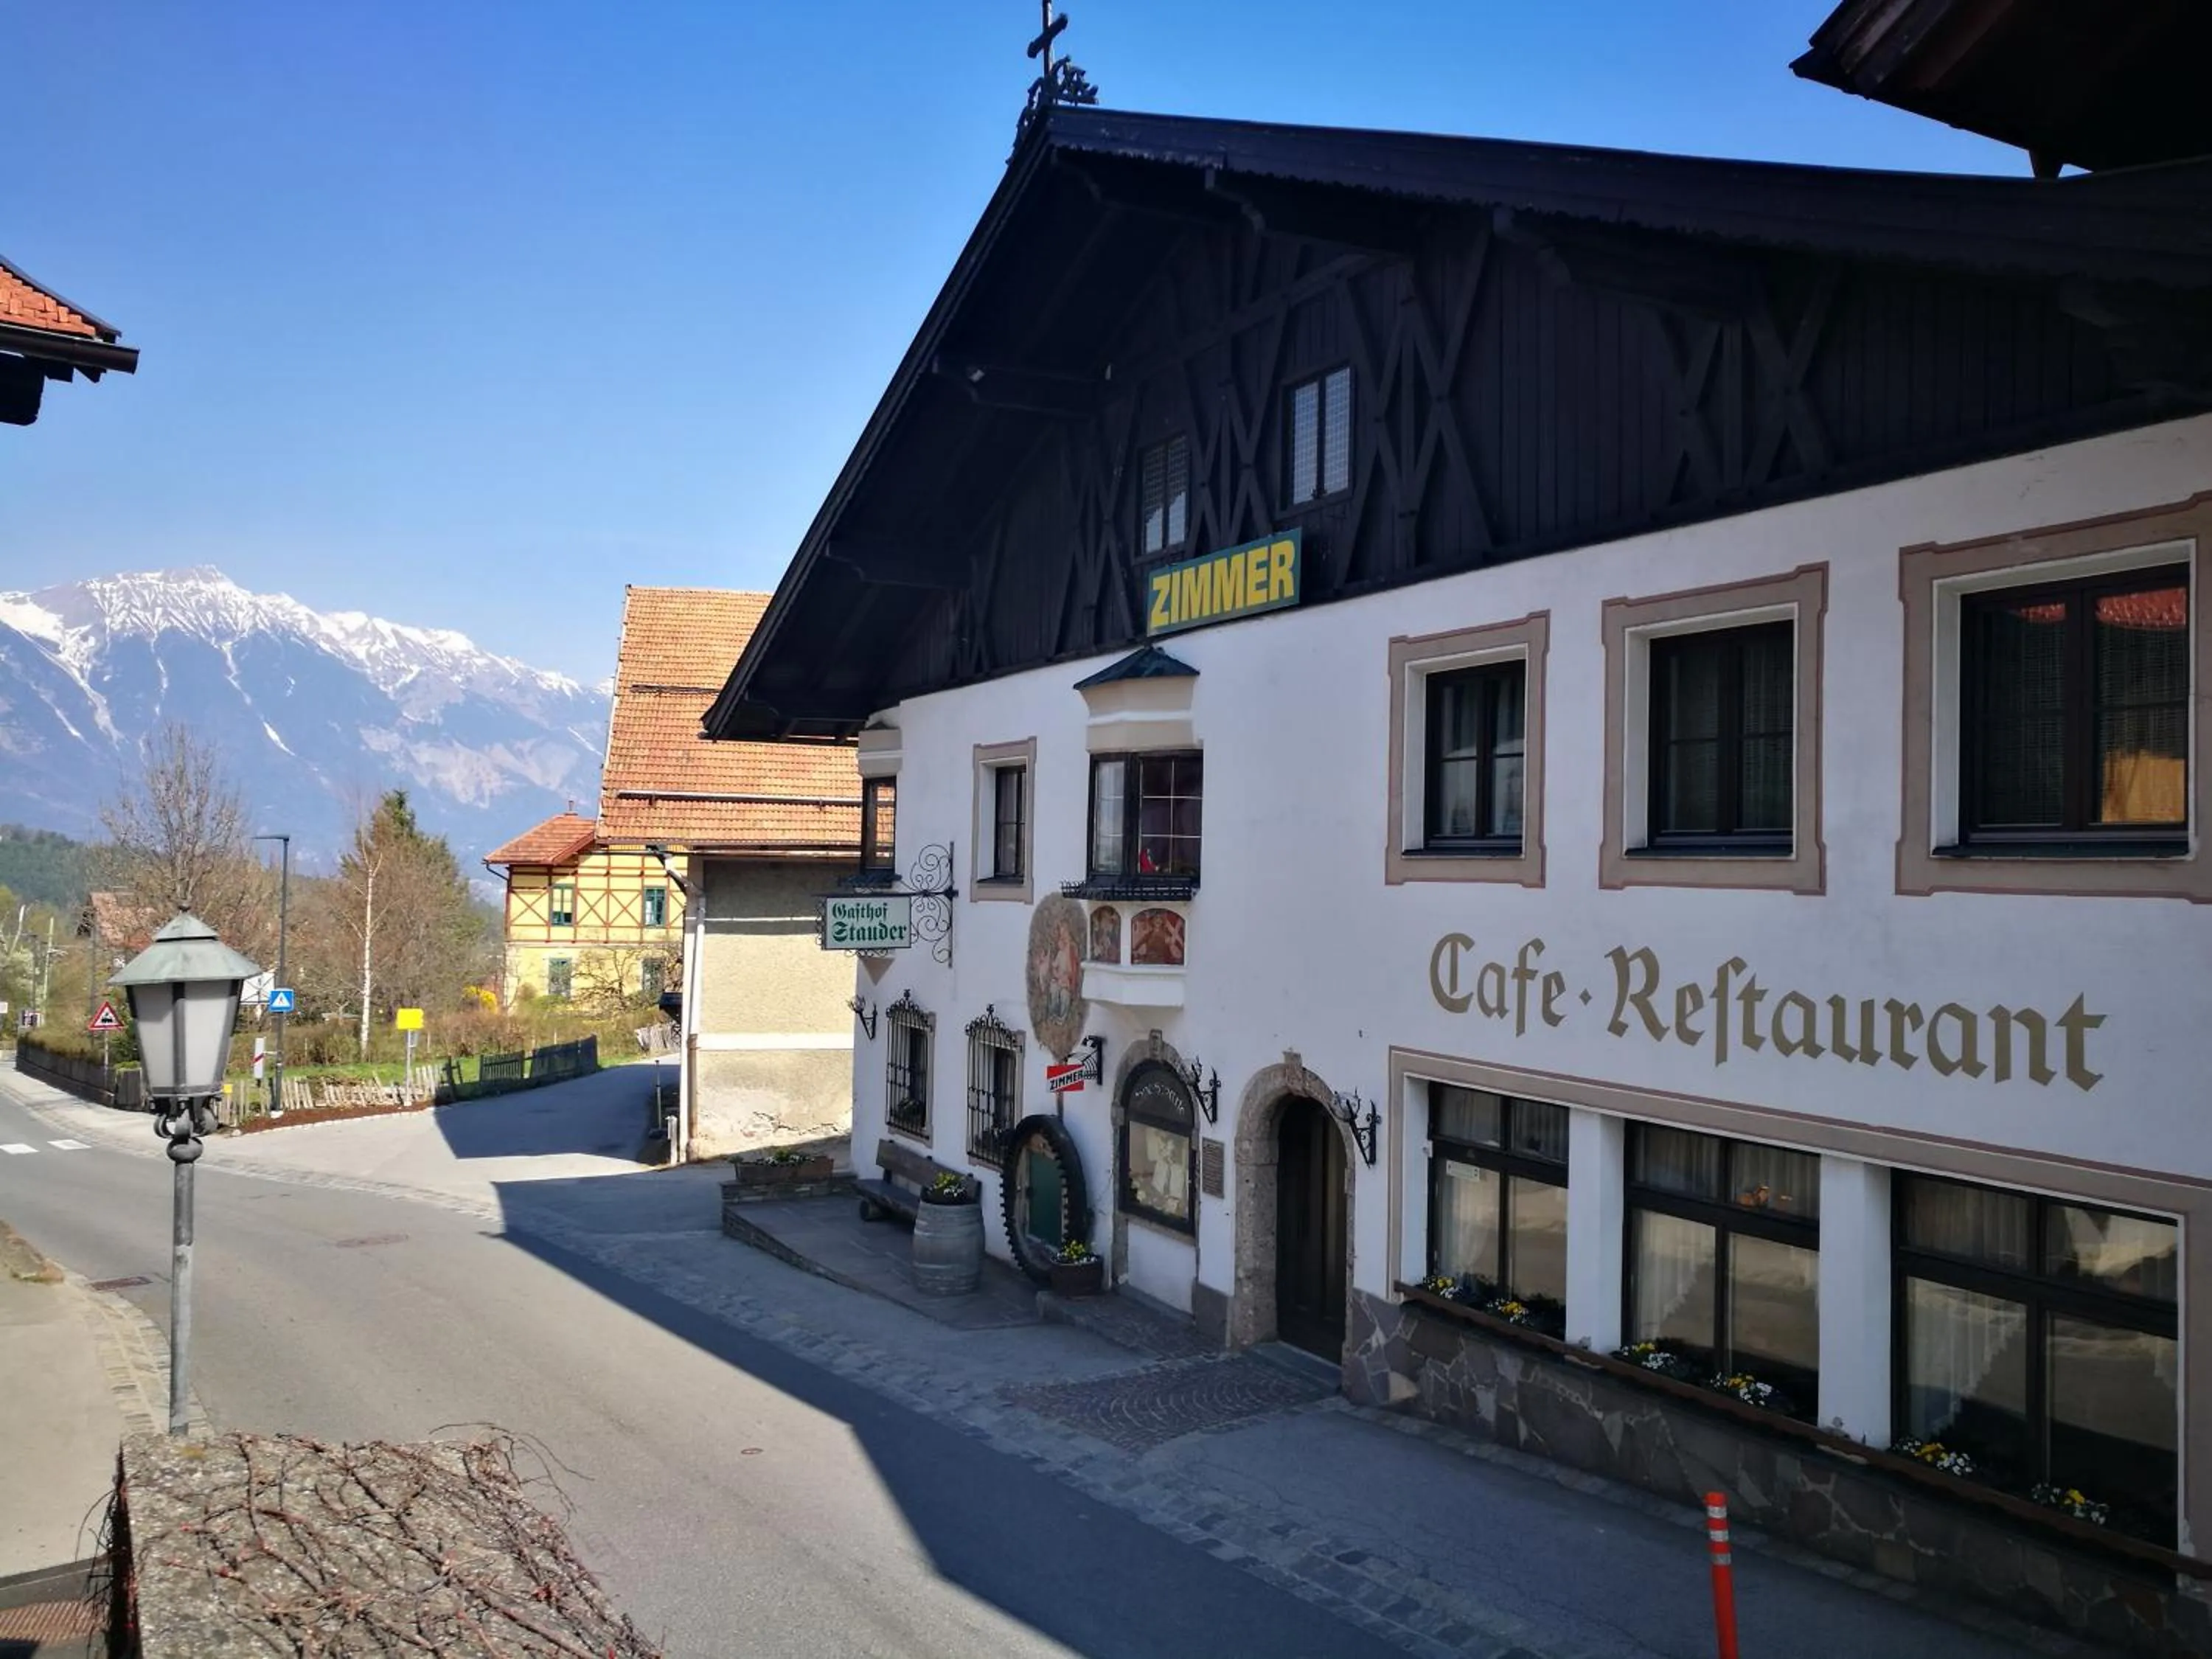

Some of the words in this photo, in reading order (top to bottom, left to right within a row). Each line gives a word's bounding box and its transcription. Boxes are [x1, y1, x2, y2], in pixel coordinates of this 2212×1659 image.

[1151, 539, 1295, 627] ZIMMER
[832, 920, 907, 942] Stauder
[1428, 932, 1567, 1038] Cafe
[1049, 1069, 1084, 1091] ZIMMER
